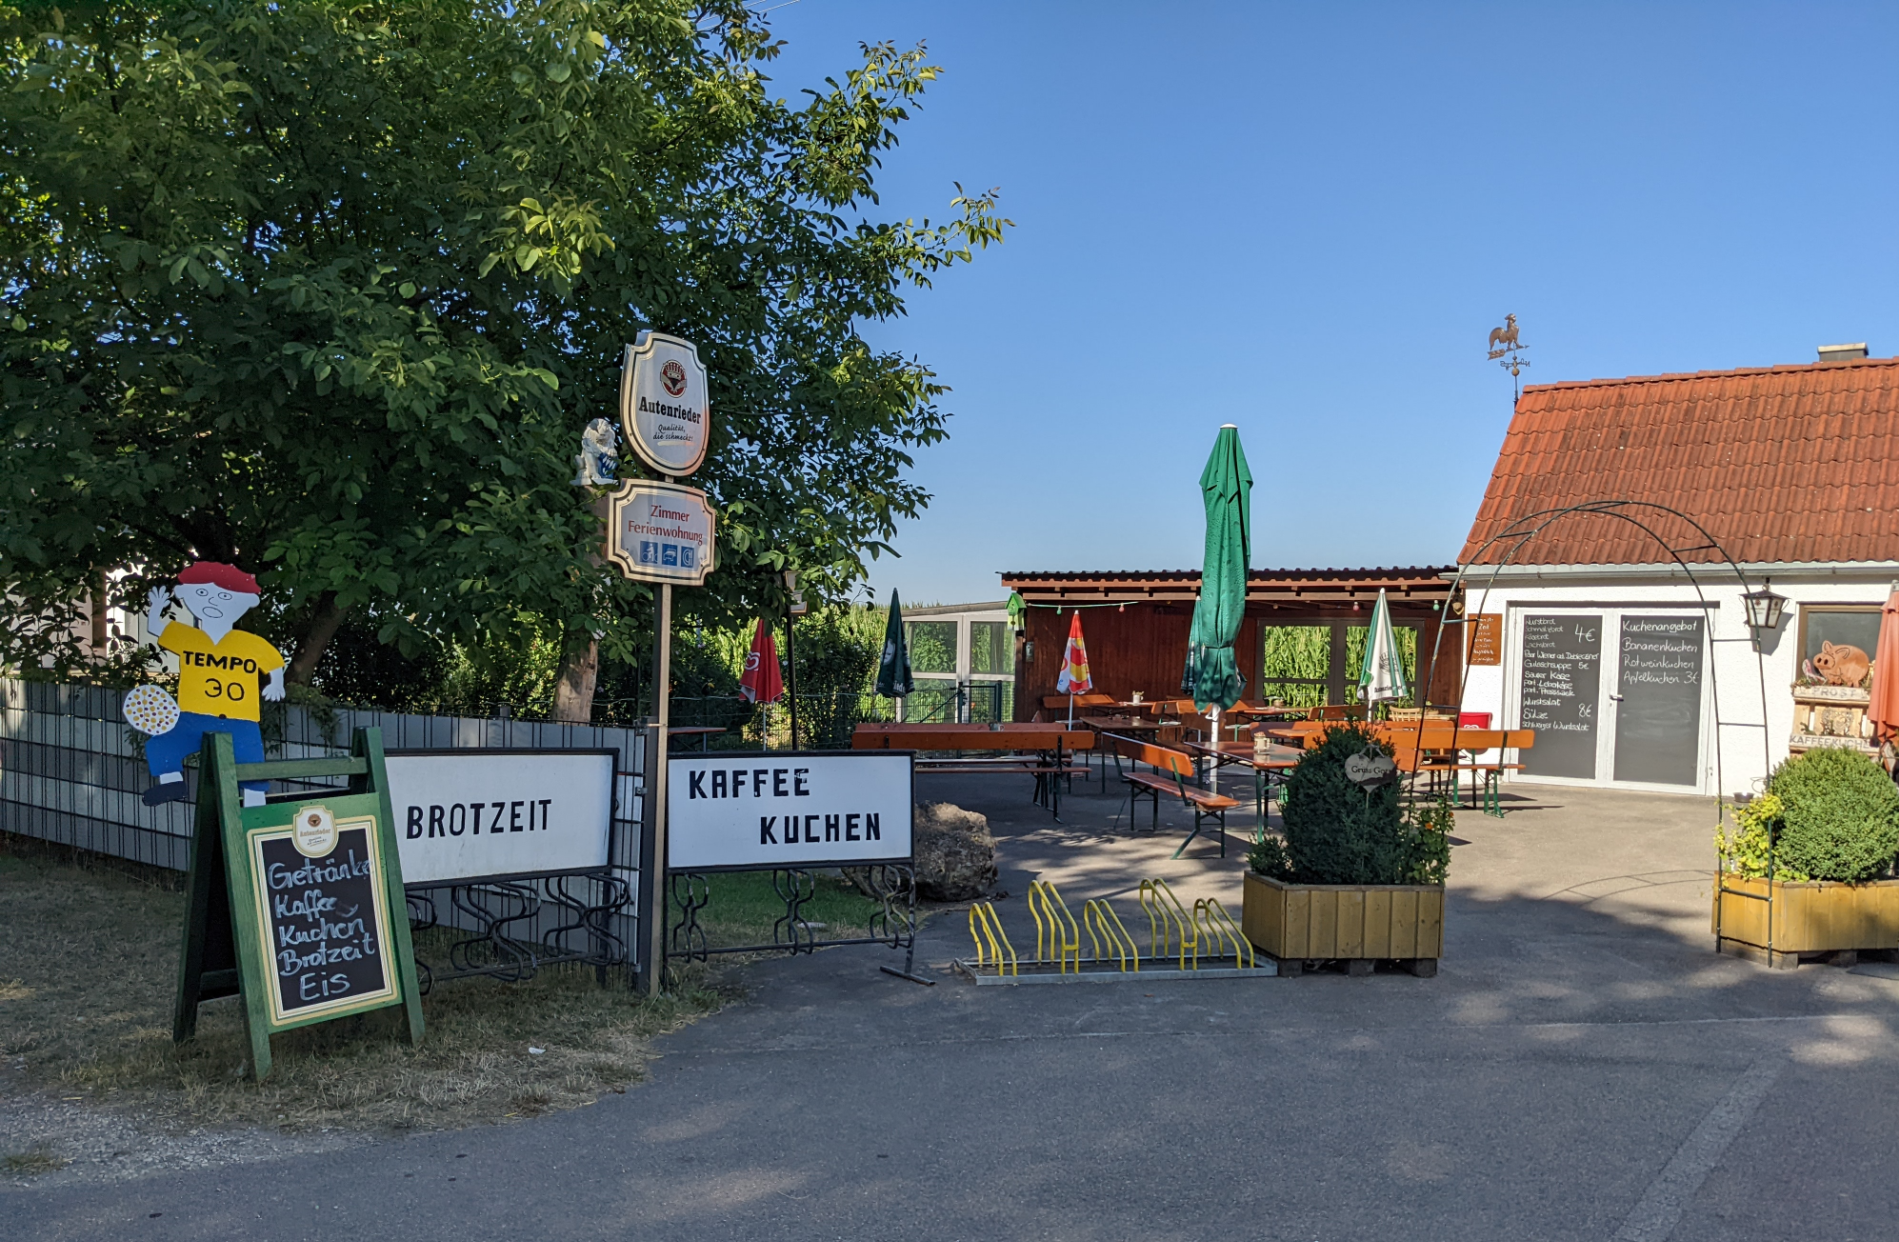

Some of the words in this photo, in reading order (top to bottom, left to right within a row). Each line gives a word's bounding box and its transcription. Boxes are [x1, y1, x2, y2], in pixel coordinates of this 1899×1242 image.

[639, 396, 701, 424] Autenrieder
[650, 505, 690, 522] Zimmer
[628, 520, 703, 546] Ferienwohnung
[1574, 623, 1596, 643] 4€
[1622, 620, 1697, 633] Kuchenangebot
[1622, 637, 1697, 653] Bananenkuchen
[183, 650, 257, 674] TEMPO
[204, 678, 245, 701] 30
[689, 768, 810, 799] KAFFEE
[406, 799, 552, 839] BROTZEIT
[760, 813, 880, 844] KUCHEN
[268, 849, 374, 889] Getränke
[275, 889, 337, 922] Kaffee
[279, 917, 365, 947] Kuchen
[278, 933, 375, 976] Brotzeit
[300, 972, 350, 1000] Eis
